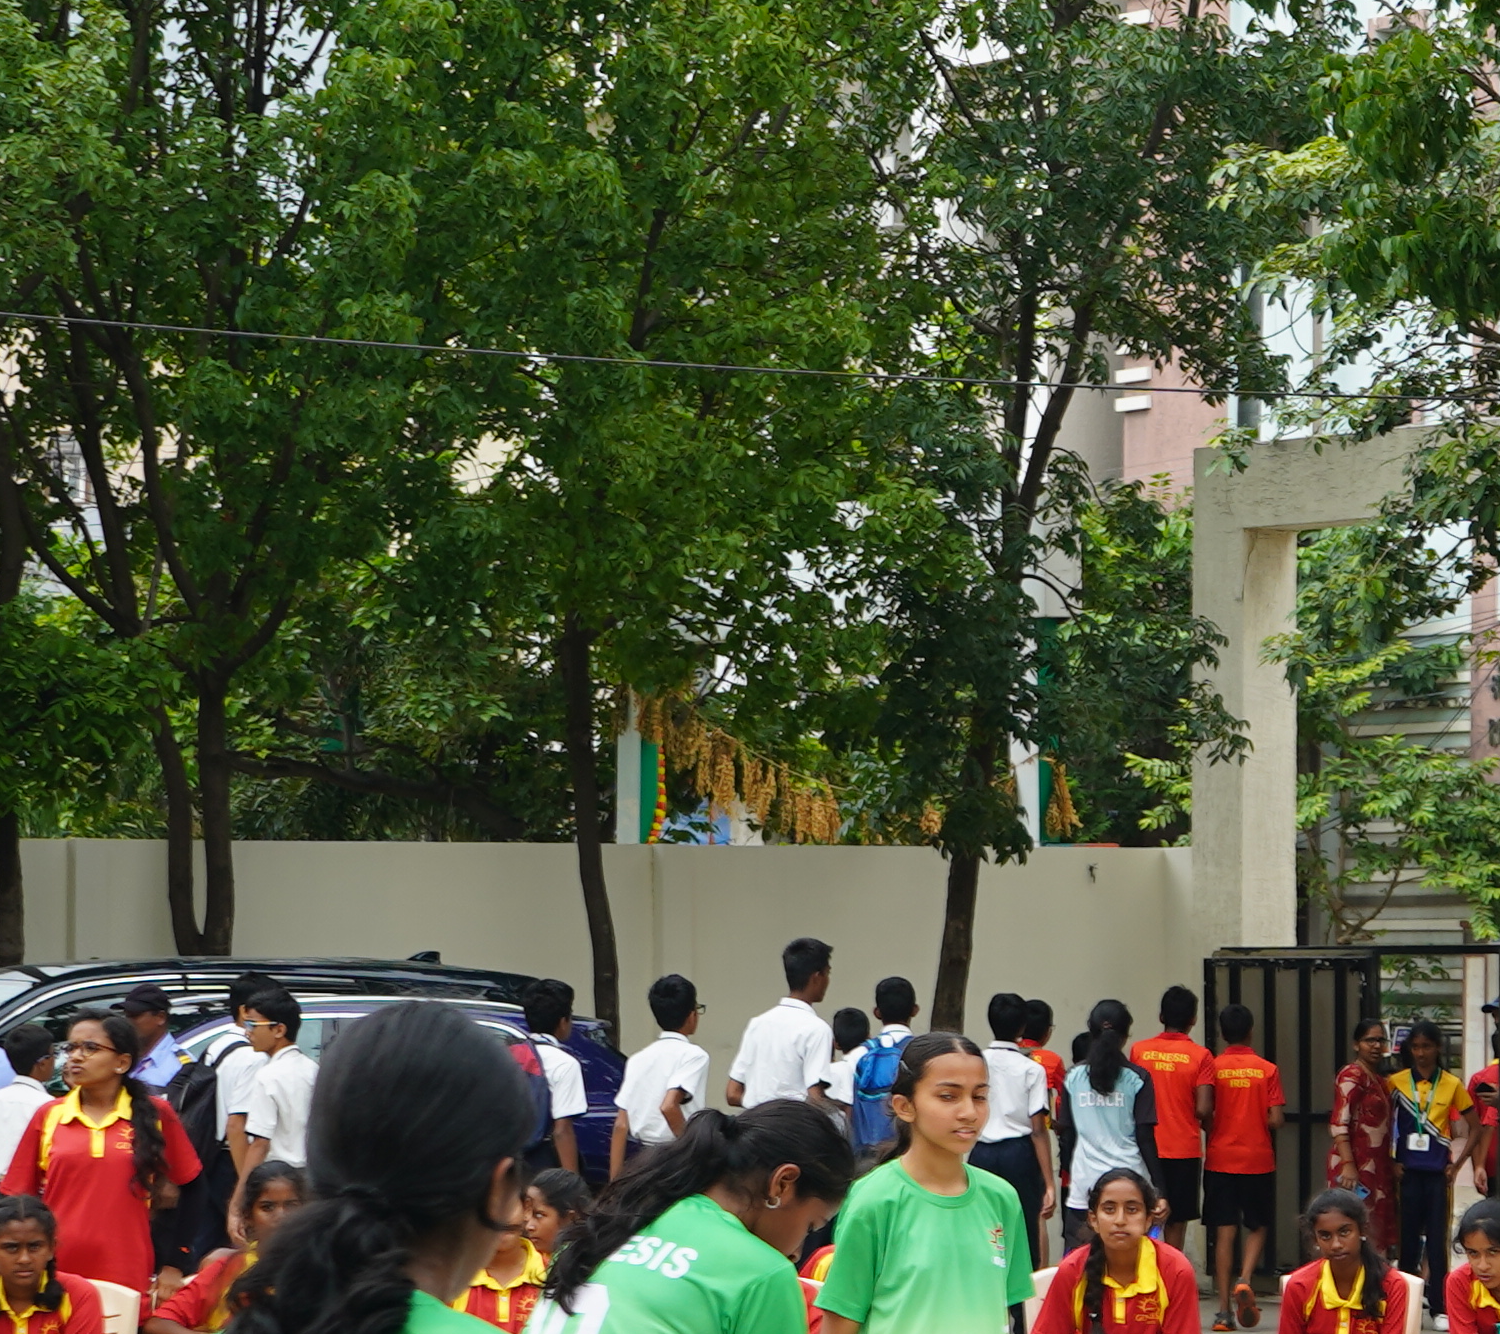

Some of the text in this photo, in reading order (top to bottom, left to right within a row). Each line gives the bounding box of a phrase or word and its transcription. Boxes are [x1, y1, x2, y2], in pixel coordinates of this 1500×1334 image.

[1142, 1050, 1191, 1064] GENESIS
[1154, 1061, 1176, 1072] IRIS
[1216, 1067, 1265, 1079] GENESIS
[1229, 1078, 1251, 1088] IRIS
[1079, 1091, 1125, 1107] COACH
[607, 1234, 699, 1279] ESIS
